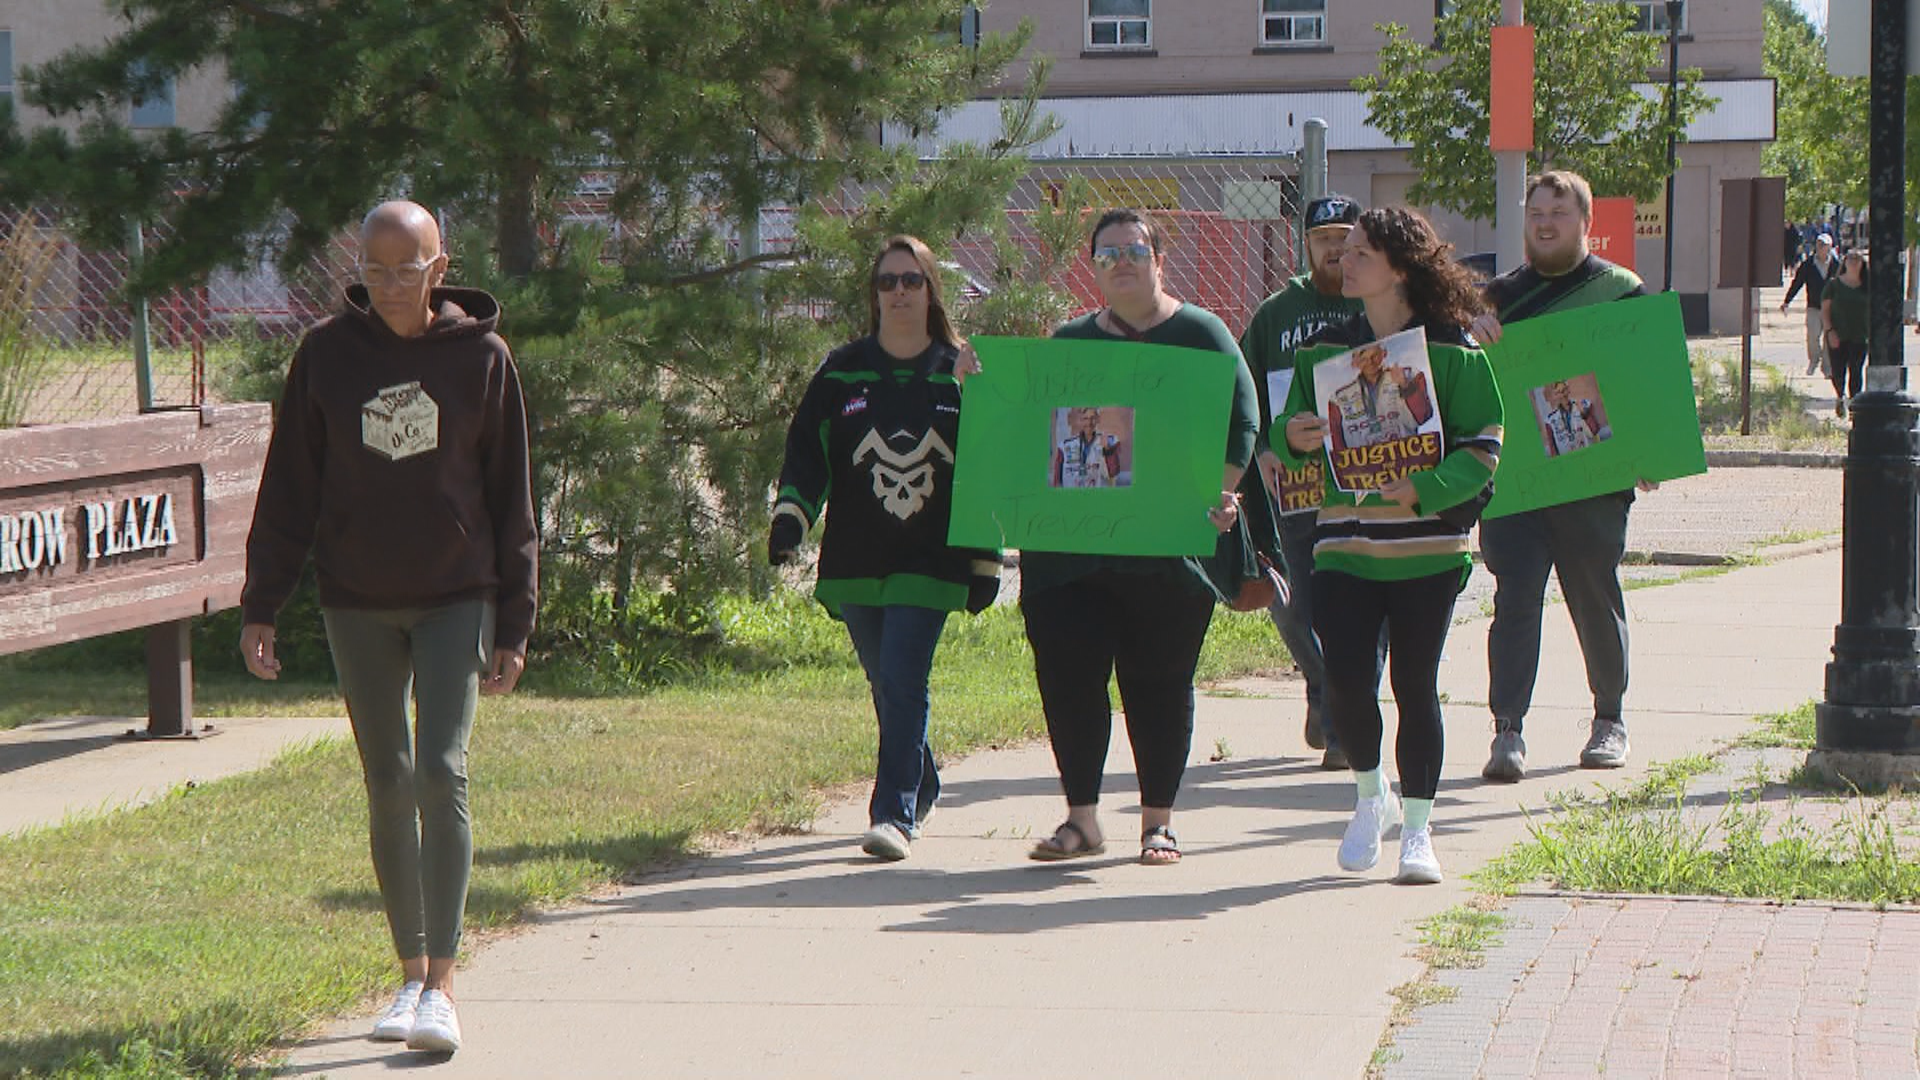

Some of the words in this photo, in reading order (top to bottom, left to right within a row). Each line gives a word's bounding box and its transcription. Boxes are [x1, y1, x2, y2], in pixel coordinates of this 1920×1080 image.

[1337, 434, 1438, 468] JUSTICE
[1343, 464, 1434, 489] TREV
[84, 494, 178, 558] PLAZA
[1001, 493, 1138, 538] Trevor
